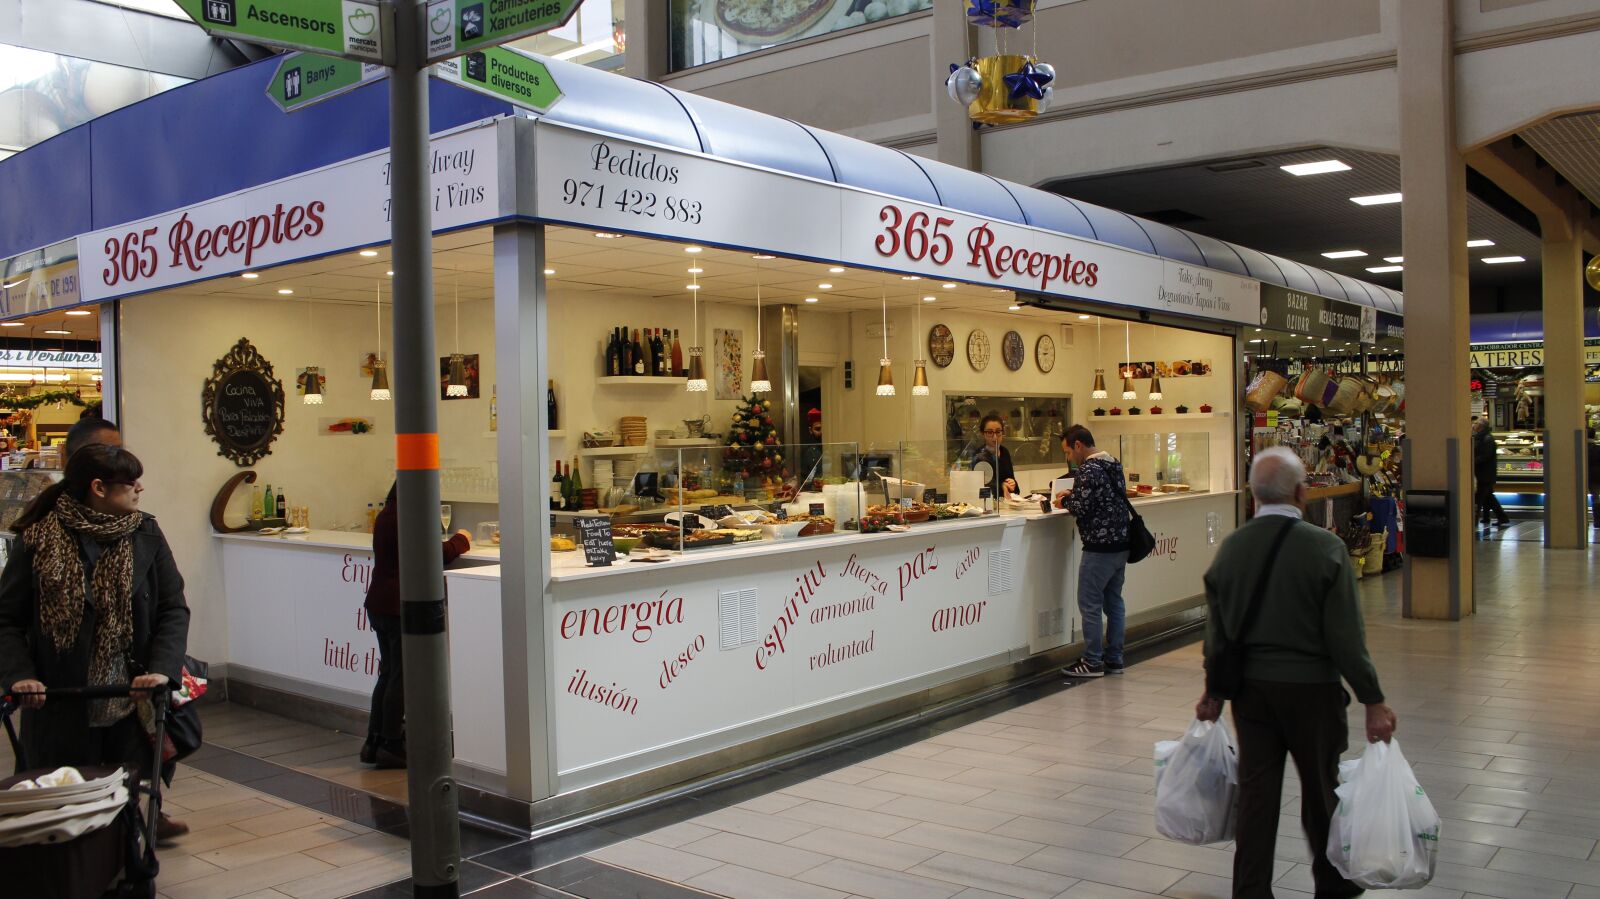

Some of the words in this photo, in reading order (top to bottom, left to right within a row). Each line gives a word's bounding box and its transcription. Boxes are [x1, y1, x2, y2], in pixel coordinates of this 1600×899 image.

[247, 4, 336, 34] Ascensors
[490, 2, 561, 32] Xarcuteries
[349, 36, 377, 47] mercats
[430, 35, 452, 46] mercats
[306, 64, 336, 84] Banys
[491, 57, 540, 86] Productes
[491, 74, 532, 98] diversos
[591, 139, 680, 185] Pedidos
[435, 187, 441, 212] i
[447, 182, 485, 209] Vins
[563, 178, 605, 209] 971
[614, 188, 657, 218] 422
[663, 195, 702, 225] 883
[102, 226, 158, 286] 365
[168, 200, 325, 272] Receptes
[874, 204, 955, 265] 365
[966, 222, 1099, 290] Receptes
[62, 275, 77, 294] 1951
[1178, 267, 1193, 285] Take
[1287, 292, 1308, 311] BAZAR
[1484, 350, 1544, 368] TERES
[225, 383, 257, 396] Cocina
[839, 552, 889, 596] fuerza
[897, 543, 940, 602] paz
[955, 545, 981, 580] éxito
[560, 589, 685, 643] energía
[755, 559, 827, 671] espíritu
[810, 592, 875, 625] armonía
[931, 600, 987, 632] amor
[324, 637, 359, 673] little
[659, 634, 705, 690] deseo
[809, 630, 875, 671] voluntad
[567, 668, 639, 715] ilusión
